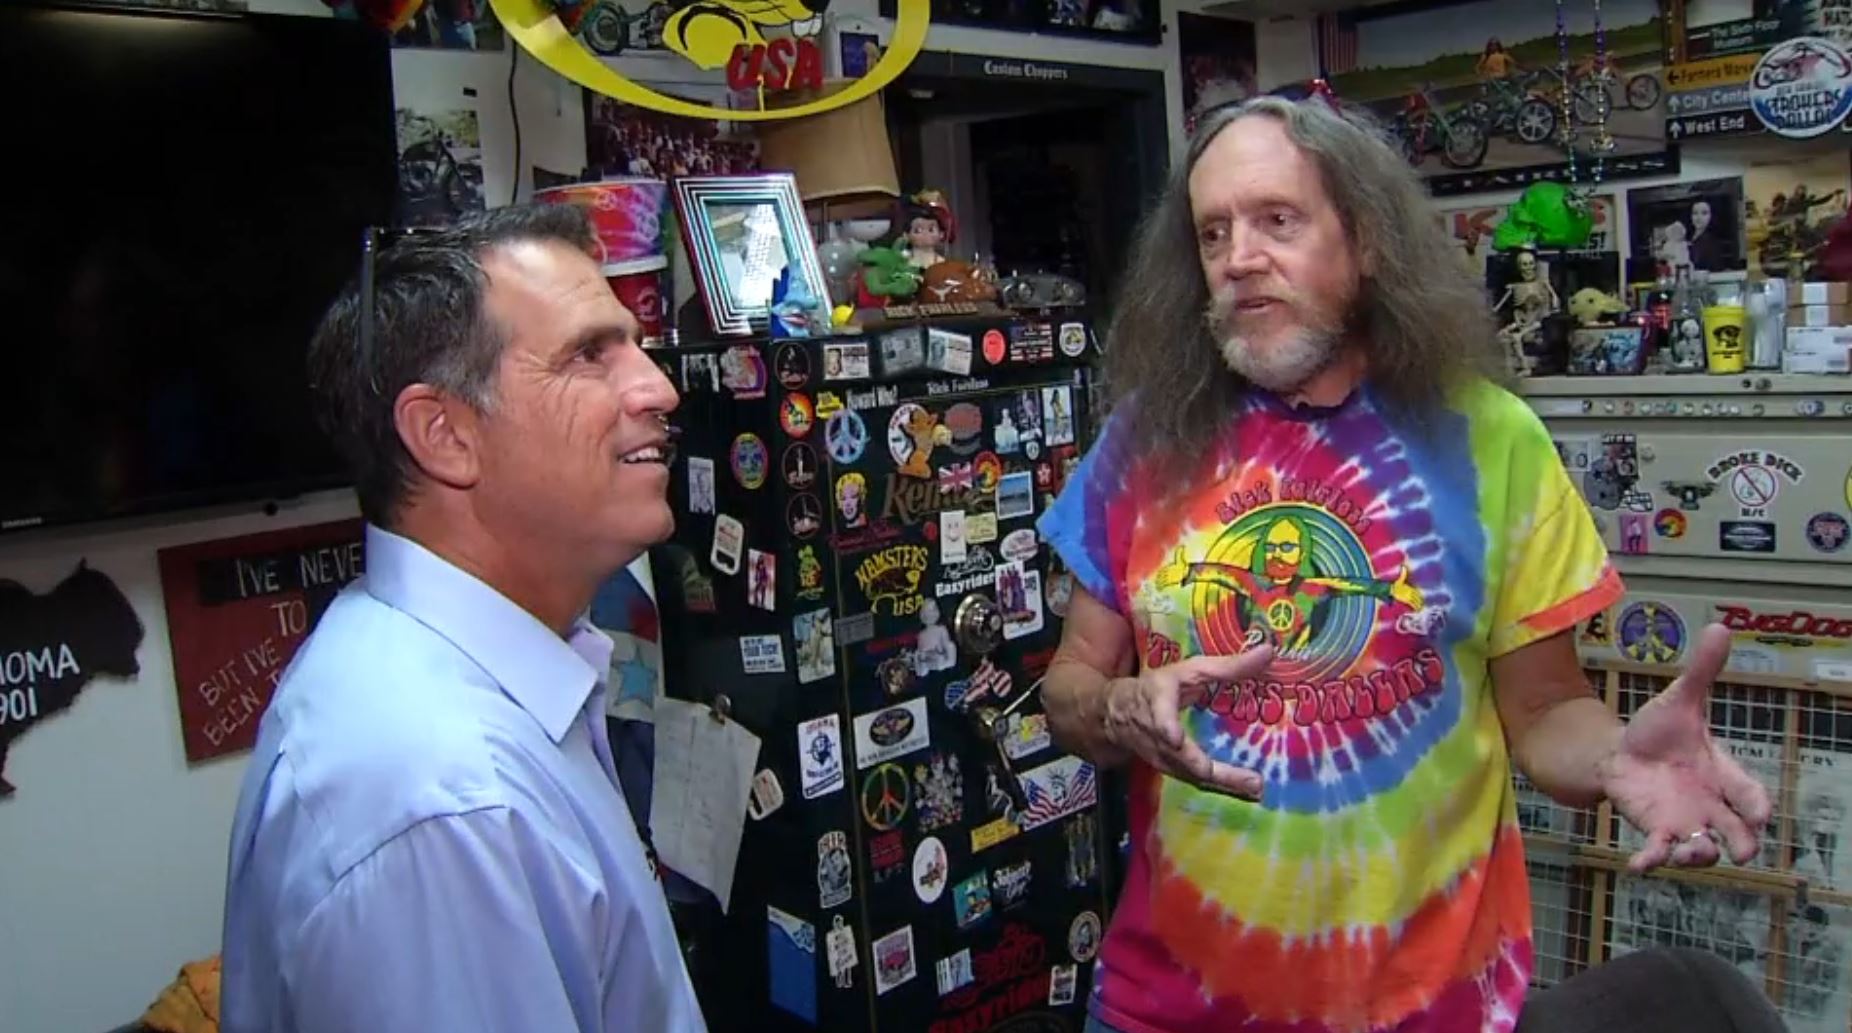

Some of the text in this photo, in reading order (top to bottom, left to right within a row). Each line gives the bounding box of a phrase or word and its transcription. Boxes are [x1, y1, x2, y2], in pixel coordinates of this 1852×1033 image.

[727, 38, 825, 92] USA
[1682, 94, 1708, 109] City
[1684, 115, 1744, 135] West End
[1707, 451, 1761, 480] BROKE
[299, 543, 363, 588] NEVE
[854, 544, 929, 588] HAMSTERS
[935, 572, 997, 598] Easyrider
[272, 600, 307, 637] TO
[0, 643, 81, 686] OMA
[200, 660, 242, 707] BUT
[1293, 649, 1444, 726] DALLAS
[203, 686, 261, 746] BEEN
